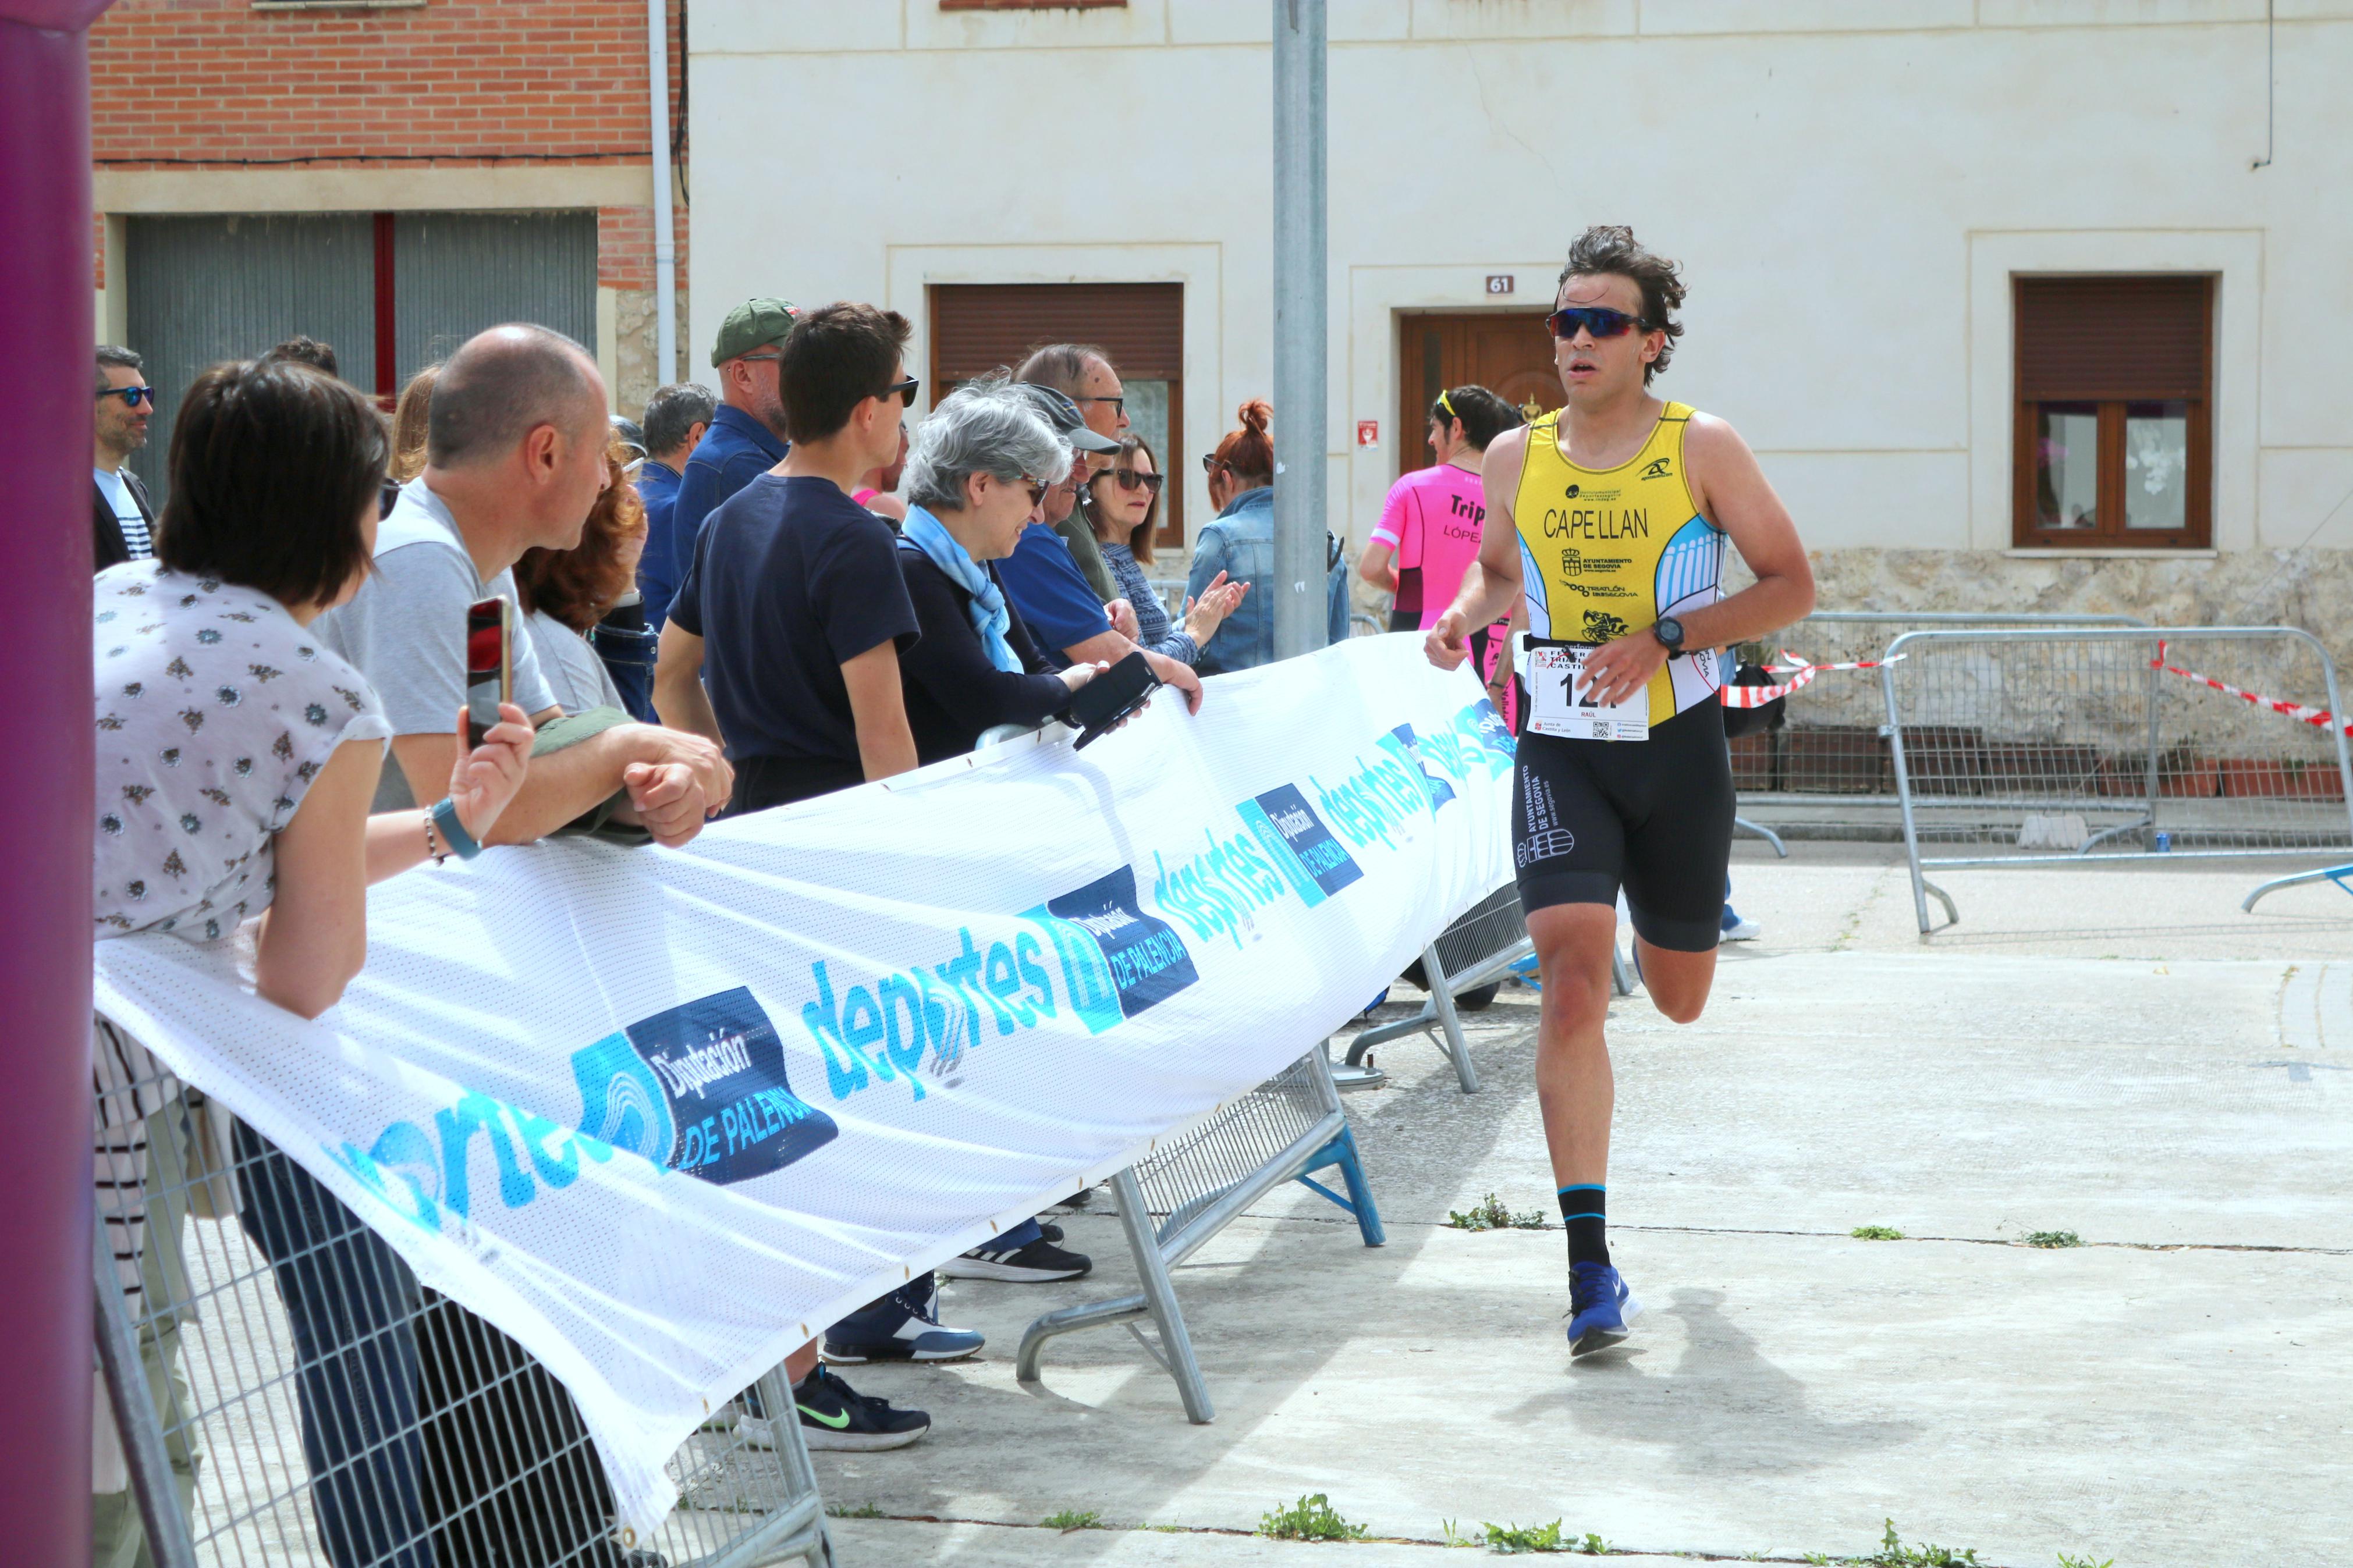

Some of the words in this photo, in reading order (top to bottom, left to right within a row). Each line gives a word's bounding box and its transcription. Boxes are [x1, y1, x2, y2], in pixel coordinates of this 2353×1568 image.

[1490, 278, 1508, 292] 61
[1451, 494, 1486, 527] Trip
[1544, 508, 1648, 539] CAPELLAN
[1443, 525, 1481, 543] LÓPE
[1522, 765, 1537, 833] AYUNTAMIENTO
[1532, 776, 1546, 815] SEGOVIA
[1543, 780, 1559, 827] www.segovia.es
[1538, 816, 1549, 830] DE
[1110, 951, 1137, 990] DE
[1126, 929, 1187, 982] PALENCIA
[802, 926, 1057, 1103] deportes
[650, 1027, 753, 1100] Diputación
[676, 1115, 722, 1171] DE
